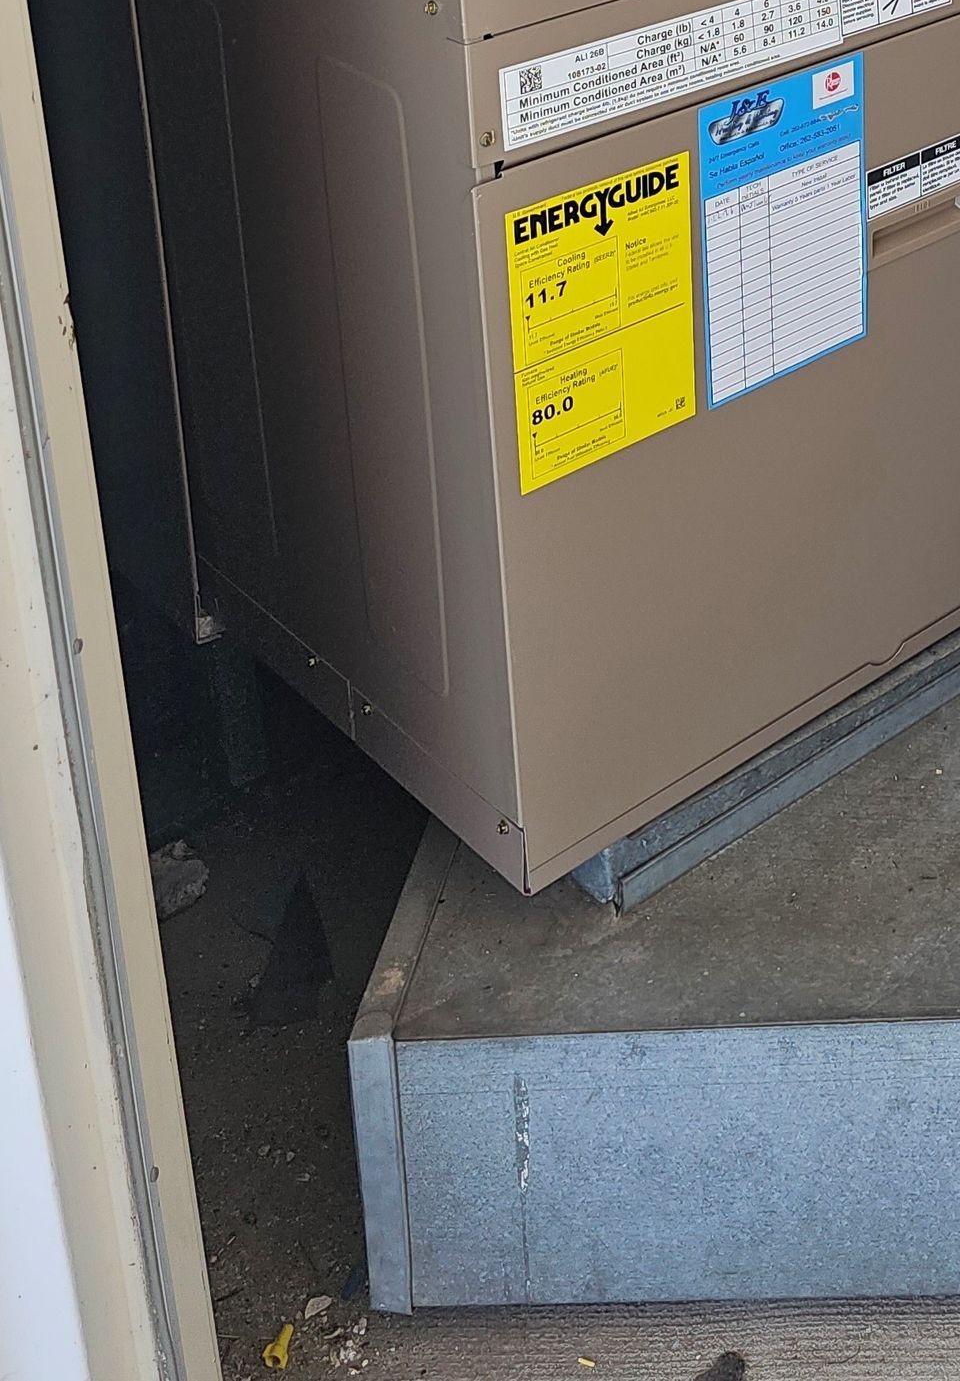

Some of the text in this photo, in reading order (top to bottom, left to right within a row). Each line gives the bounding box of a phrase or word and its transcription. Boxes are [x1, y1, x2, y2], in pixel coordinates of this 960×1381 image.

[636, 43, 671, 59] Charge
[674, 35, 693, 50] (kg)
[706, 27, 720, 38] 1.8
[732, 19, 745, 30] 1.8
[761, 10, 775, 21] 2.7
[788, 2, 801, 12] 3.6
[637, 29, 673, 45] Charge
[675, 22, 692, 37] (lb)
[709, 15, 715, 24] 4
[734, 8, 740, 16] 4
[763, 0, 770, 8] 6
[519, 88, 570, 110] Minimum
[573, 66, 638, 93] Conditioned
[640, 59, 664, 73] Area
[666, 50, 684, 65] (ft²)
[733, 33, 745, 43] 60
[763, 23, 774, 34] 90
[788, 15, 803, 26] 120
[817, 6, 831, 18] 150
[590, 48, 605, 61] 26B
[520, 102, 570, 123] Minimum
[573, 80, 637, 106] Conditioned
[639, 72, 663, 86] Area
[666, 65, 686, 80] (m²)
[733, 45, 747, 56] 5.6
[763, 35, 776, 47] 8.4
[788, 27, 806, 39] 11.2
[816, 18, 834, 30] 14.0
[568, 62, 606, 80] 108173-02
[728, 89, 770, 124] J&E
[779, 141, 800, 152] Office:
[935, 141, 956, 156] FILTRE
[709, 152, 765, 179] Se Habla Español
[791, 155, 838, 178] TYPE OF SERVICE
[883, 162, 906, 177] FILTER
[842, 173, 856, 184] Labor
[513, 163, 679, 245] ENERGYGUIDE
[714, 196, 730, 208] DATE
[625, 237, 647, 250] Notice
[557, 251, 586, 269] Cooling
[529, 260, 591, 289] Efficiency Rating
[525, 280, 567, 309] 11.7
[560, 368, 588, 384] Heating
[535, 375, 596, 404] Efficiency Rating
[532, 396, 574, 426] 80.0
